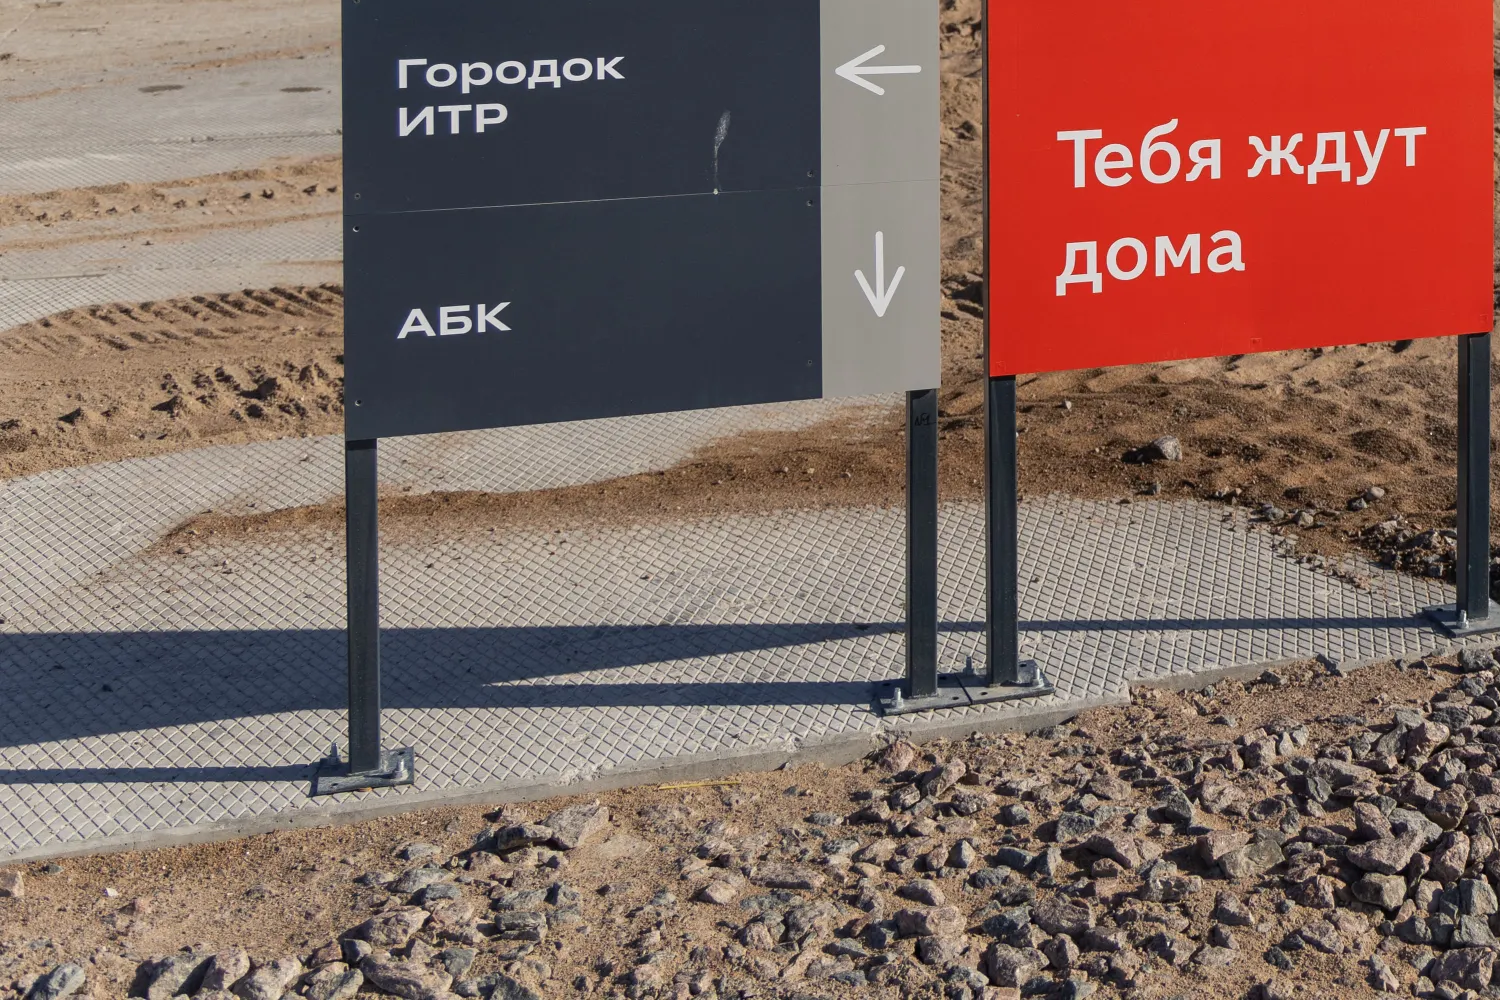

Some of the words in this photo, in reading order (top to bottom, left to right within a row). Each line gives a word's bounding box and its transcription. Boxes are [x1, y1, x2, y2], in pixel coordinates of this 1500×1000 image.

[398, 56, 625, 94] Городок
[399, 103, 508, 137] ИТР
[1056, 118, 1221, 188] Тебя
[1247, 126, 1427, 186] ждут
[1055, 229, 1246, 297] дома
[397, 301, 512, 339] АБК
